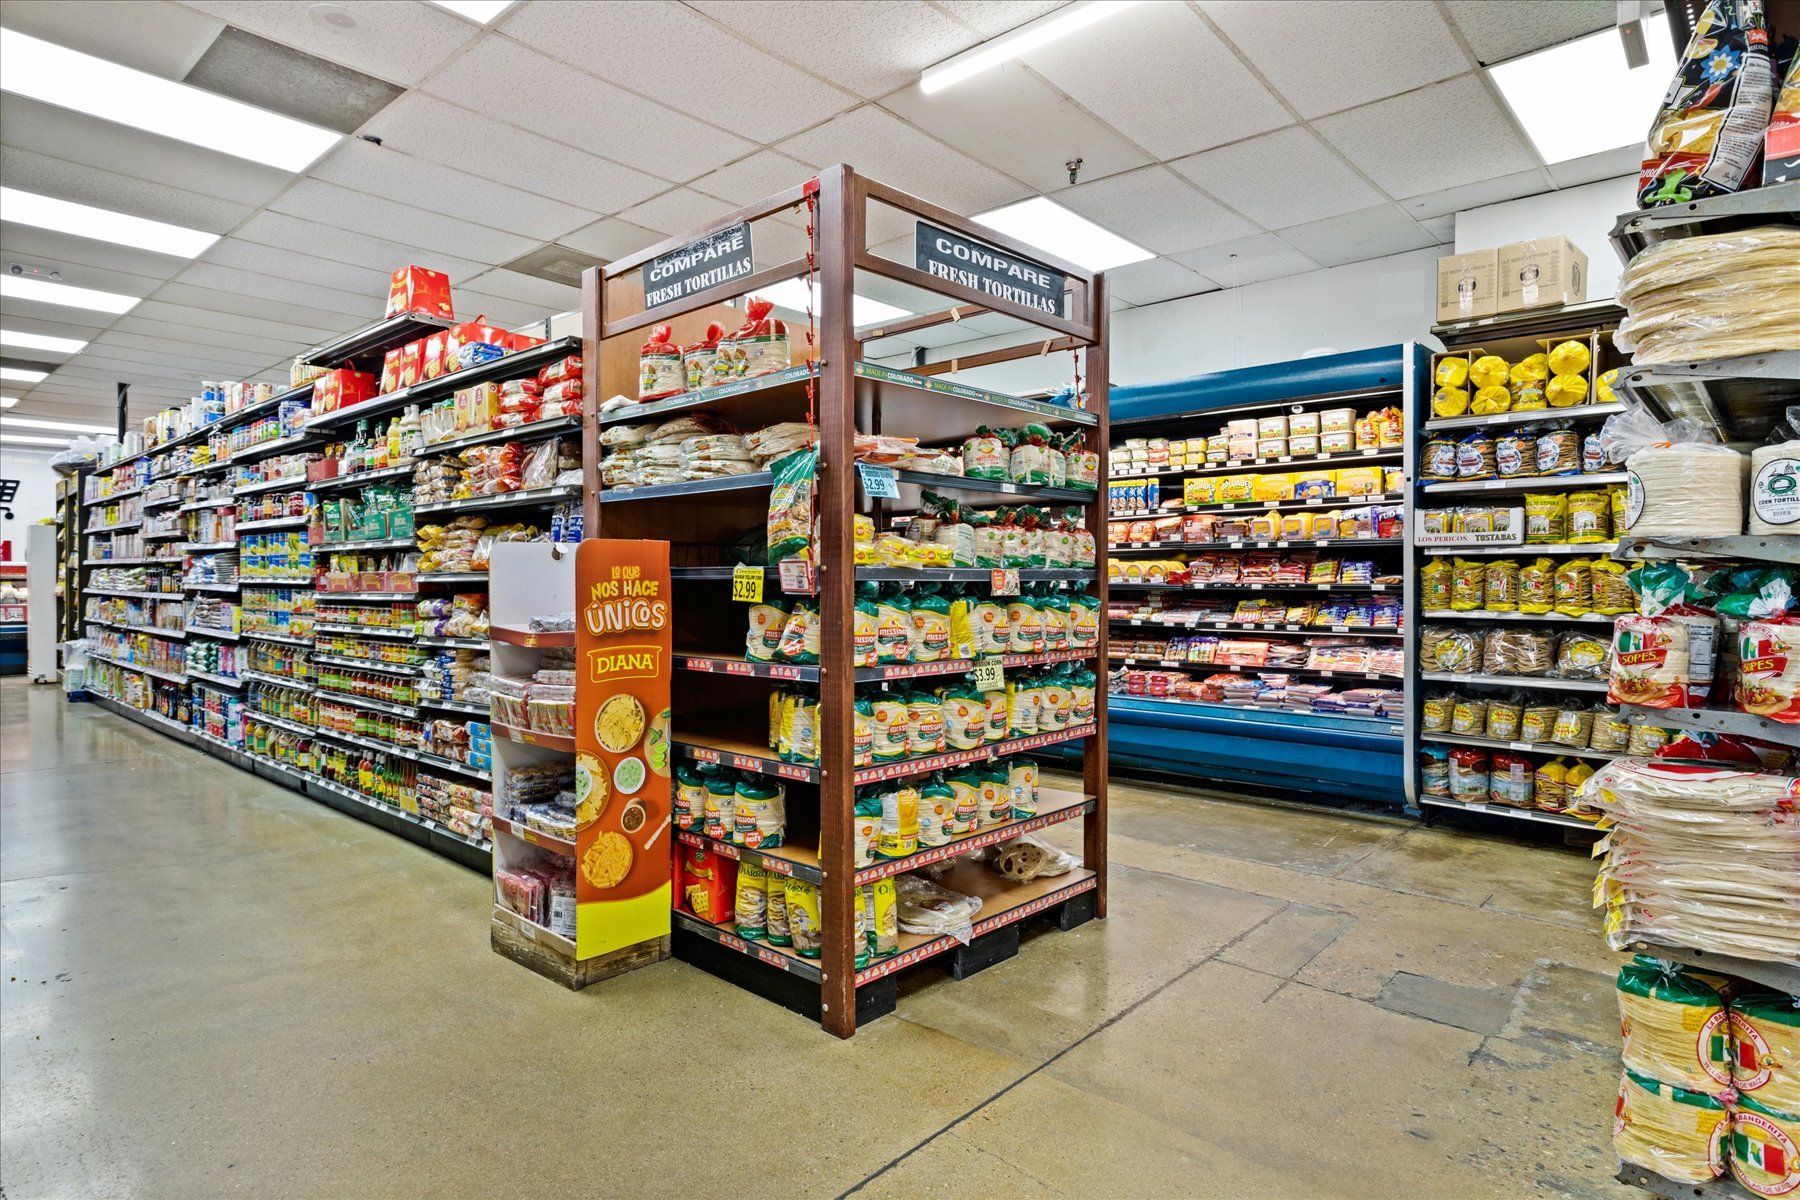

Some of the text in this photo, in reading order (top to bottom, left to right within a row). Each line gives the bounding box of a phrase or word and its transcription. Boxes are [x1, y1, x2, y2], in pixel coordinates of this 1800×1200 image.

[650, 236, 744, 281] COMPARE
[936, 238, 1050, 289] COMPARE
[646, 257, 751, 307] FRESH TORTILLAS
[928, 259, 1056, 315] FRESH TORTILLAS
[785, 367, 811, 380] COLORADO
[888, 370, 914, 384] COLORADO
[718, 384, 741, 395] COLORADO
[952, 385, 976, 397] COLORADO
[864, 478, 885, 490] $2.99
[1379, 511, 1396, 521] FUD
[1434, 535, 1468, 543] PERICOS
[1475, 533, 1517, 542] TOSTADAS
[591, 579, 659, 601] NOS HACE
[733, 580, 756, 599] $2.99
[597, 653, 654, 674] DIANA
[1622, 651, 1657, 664] SOPES
[1743, 659, 1774, 673] SOPES
[974, 667, 996, 682] $3.99
[745, 835, 761, 843] soft
[1706, 1021, 1714, 1030] LA
[1738, 1114, 1787, 1144] BANDERITA
